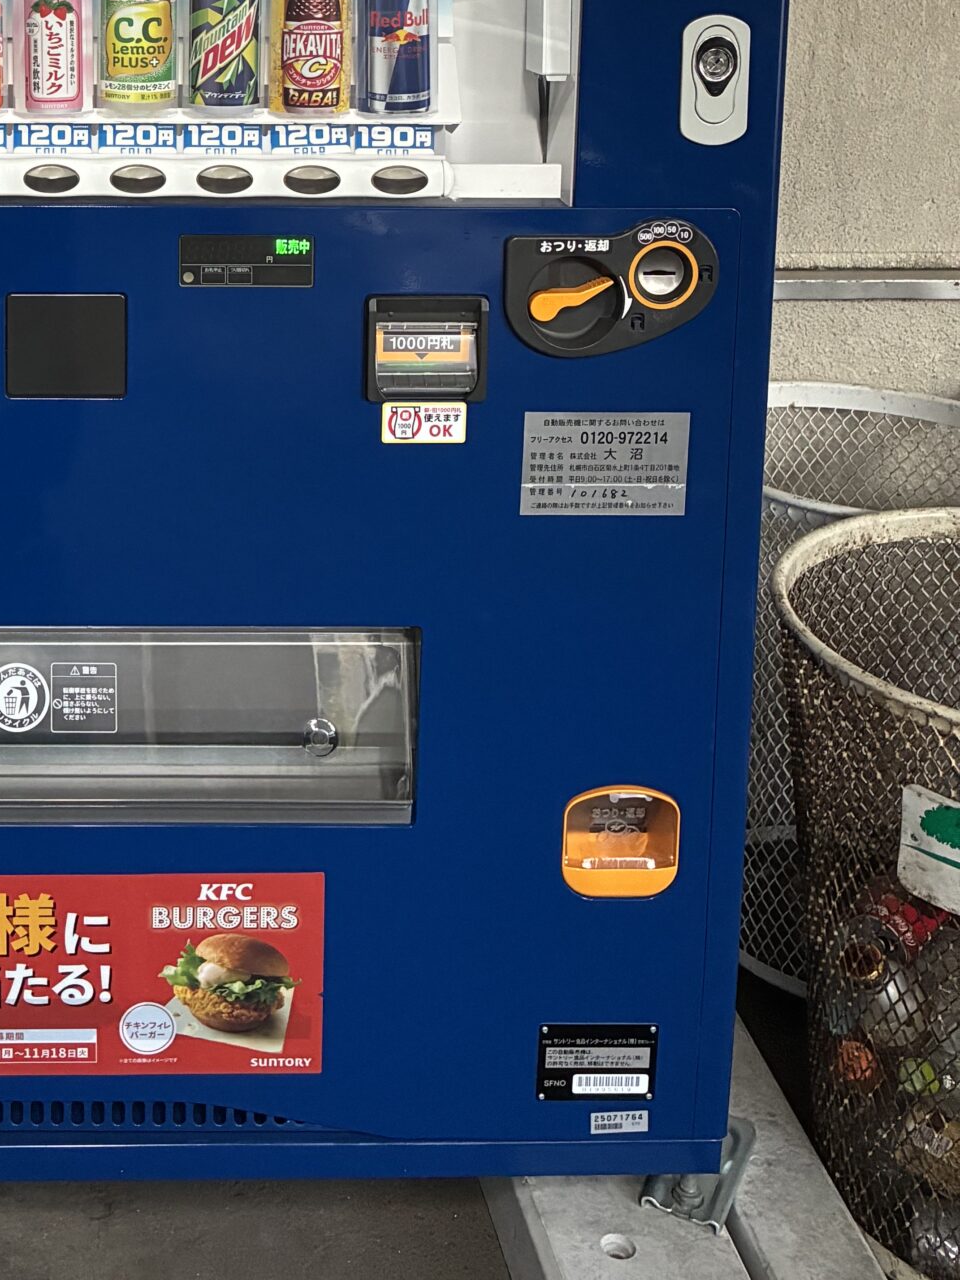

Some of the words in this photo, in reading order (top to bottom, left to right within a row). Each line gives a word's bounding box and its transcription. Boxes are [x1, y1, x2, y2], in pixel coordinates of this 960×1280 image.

[370, 11, 401, 28] Red
[403, 10, 429, 27] Bull
[114, 17, 168, 43] C.C.
[112, 43, 166, 56] Lemon
[45, 20, 65, 96] いちごミルク
[289, 90, 331, 106] GABA
[17, 125, 89, 145] 120円
[102, 125, 174, 145] 120円
[188, 125, 260, 145] 120円
[274, 125, 347, 145] 120円
[358, 126, 432, 146] 190円
[275, 239, 310, 255] 販売中
[540, 239, 610, 253] おつり・返却
[266, 255, 273, 263] 円
[389, 335, 454, 350] 1000円札
[424, 413, 461, 422] 使えます
[429, 425, 453, 437] OK
[530, 436, 573, 444] フリーアクセス
[580, 432, 669, 445] 0120-972214
[571, 488, 628, 499] 101682
[197, 883, 253, 900] KFC
[152, 906, 298, 929] BURGERS
[125, 1022, 171, 1030] チキンフィレ
[130, 1031, 165, 1039] バーガー
[250, 1057, 312, 1067] SUNTORY
[594, 1114, 643, 1123] 25071764
